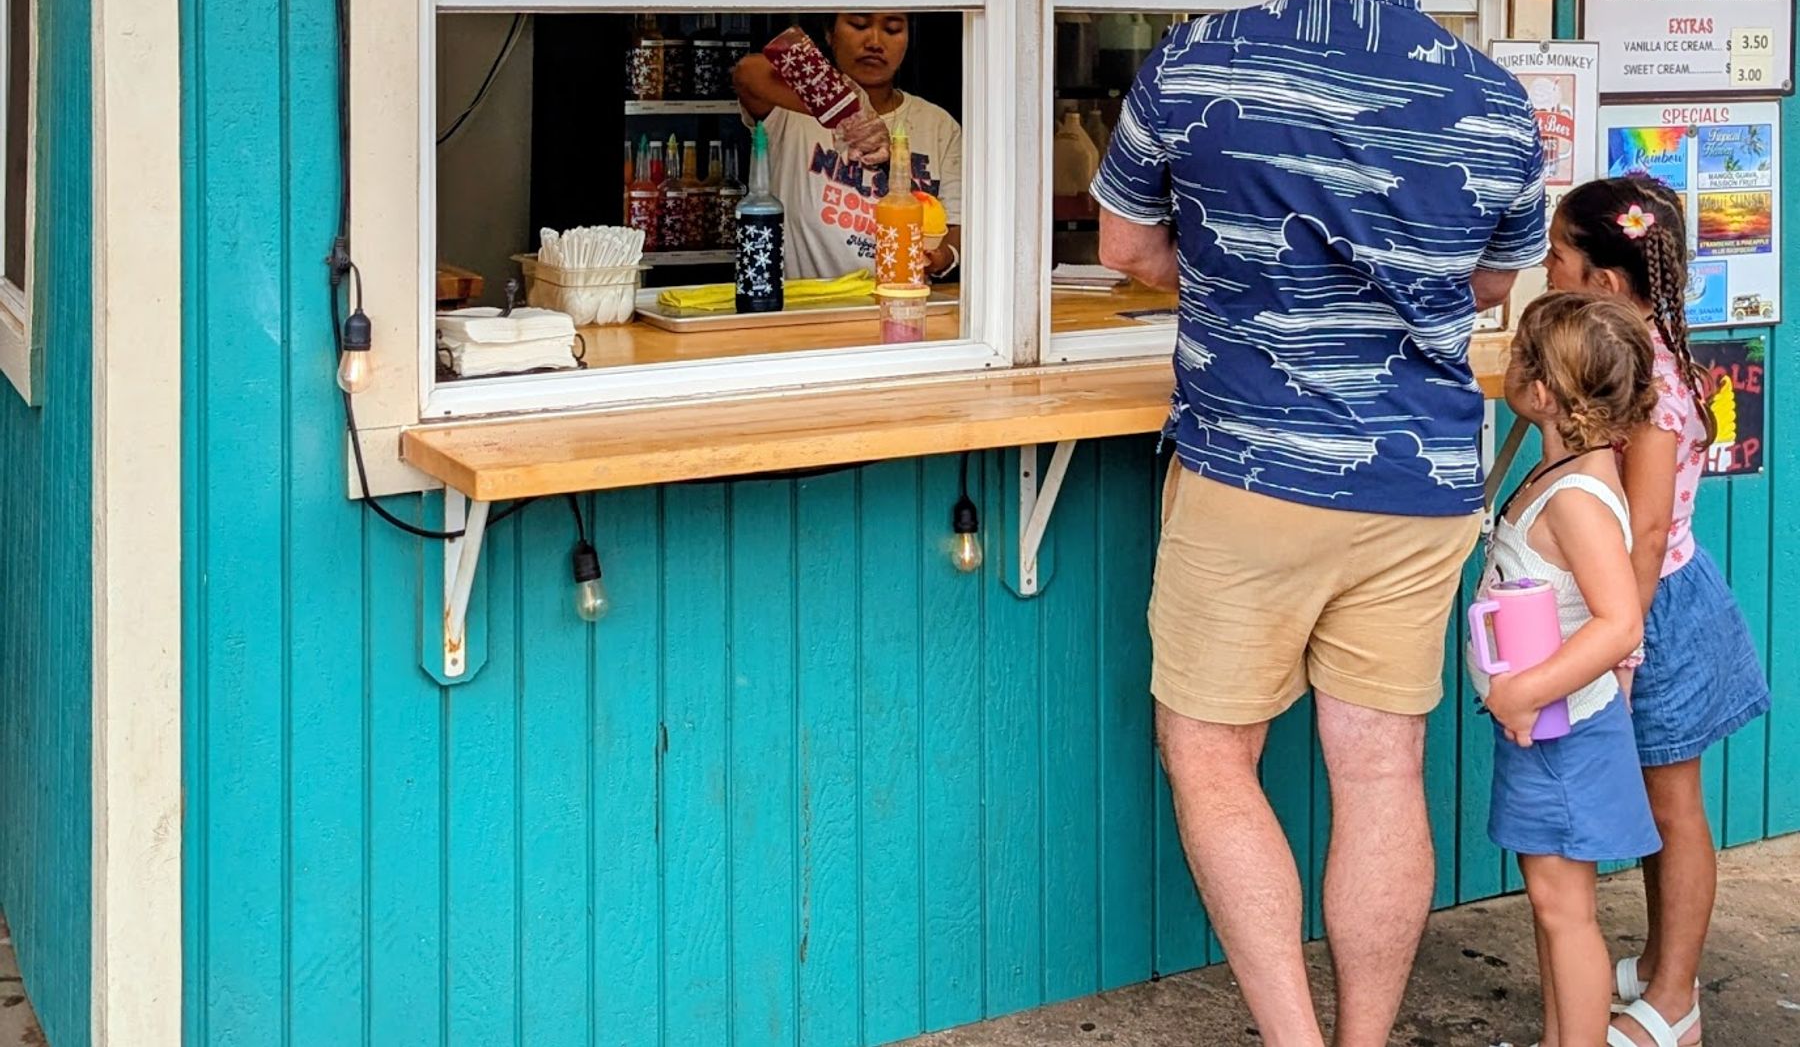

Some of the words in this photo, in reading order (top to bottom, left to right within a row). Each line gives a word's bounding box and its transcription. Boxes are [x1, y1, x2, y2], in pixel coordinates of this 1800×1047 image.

[1669, 18, 1713, 34] EXTRAS
[1624, 41, 1661, 52] VANILLA
[1664, 41, 1678, 52] ICE
[1742, 35, 1768, 49] 3.50
[1547, 54, 1594, 69] MONKEY
[1624, 64, 1654, 75] SWEET
[1738, 69, 1762, 81] 3.00
[1662, 108, 1730, 124] SPECIALS
[1544, 115, 1571, 136] Beer
[1703, 438, 1760, 472] HIP
